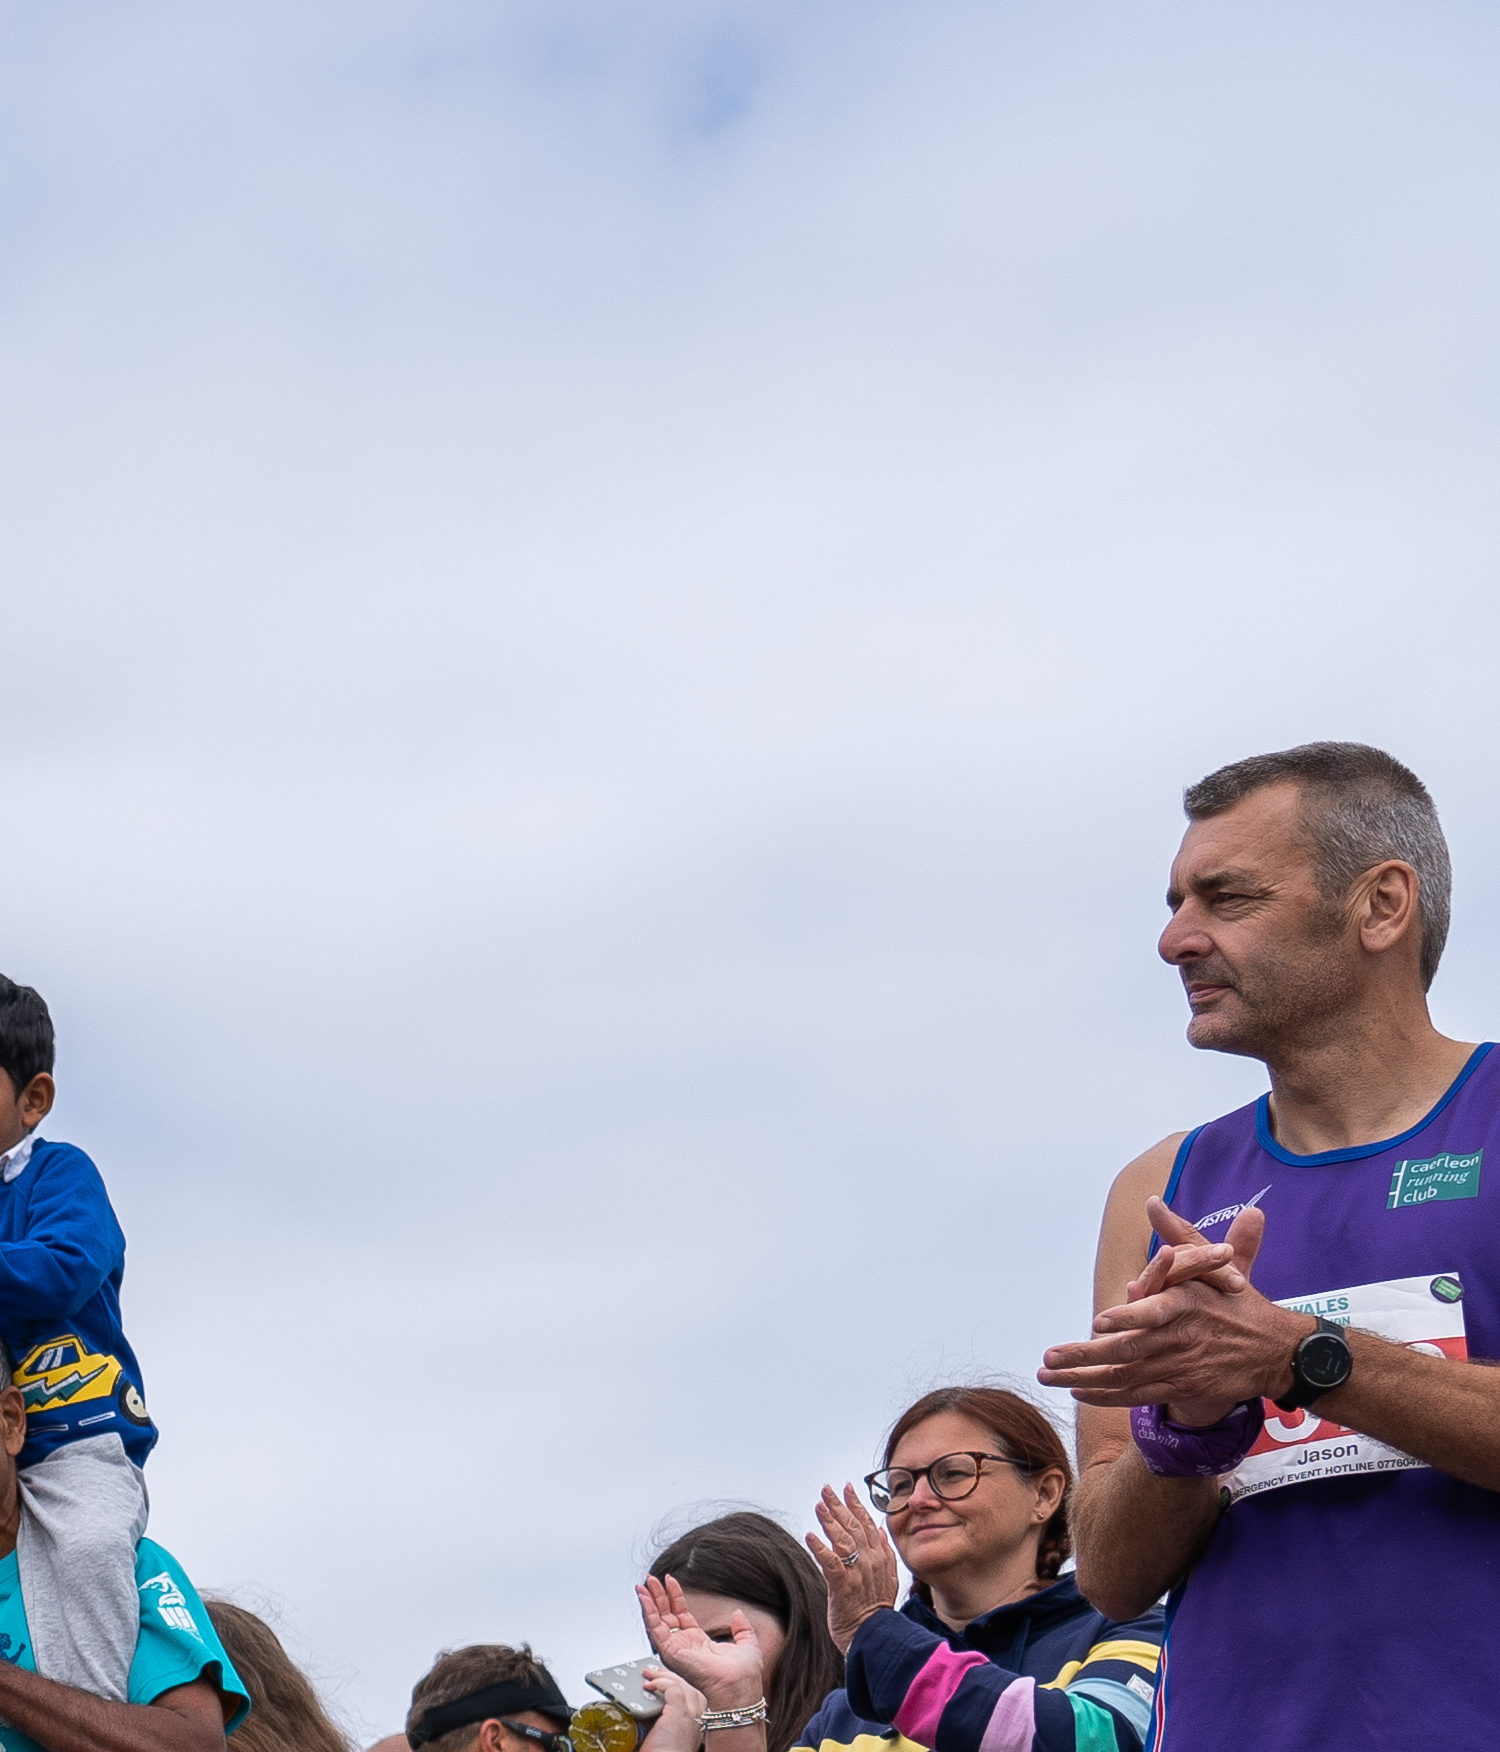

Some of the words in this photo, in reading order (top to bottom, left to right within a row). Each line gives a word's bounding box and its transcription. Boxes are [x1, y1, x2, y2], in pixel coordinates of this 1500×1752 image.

[1410, 1153, 1480, 1174] caerleon
[1405, 1170, 1470, 1188] running
[1403, 1186, 1439, 1204] club
[1287, 1297, 1349, 1316] WALES
[1297, 1444, 1359, 1466] Jason
[1287, 1467, 1323, 1483] EVENT
[1325, 1461, 1375, 1476] HOTLINE
